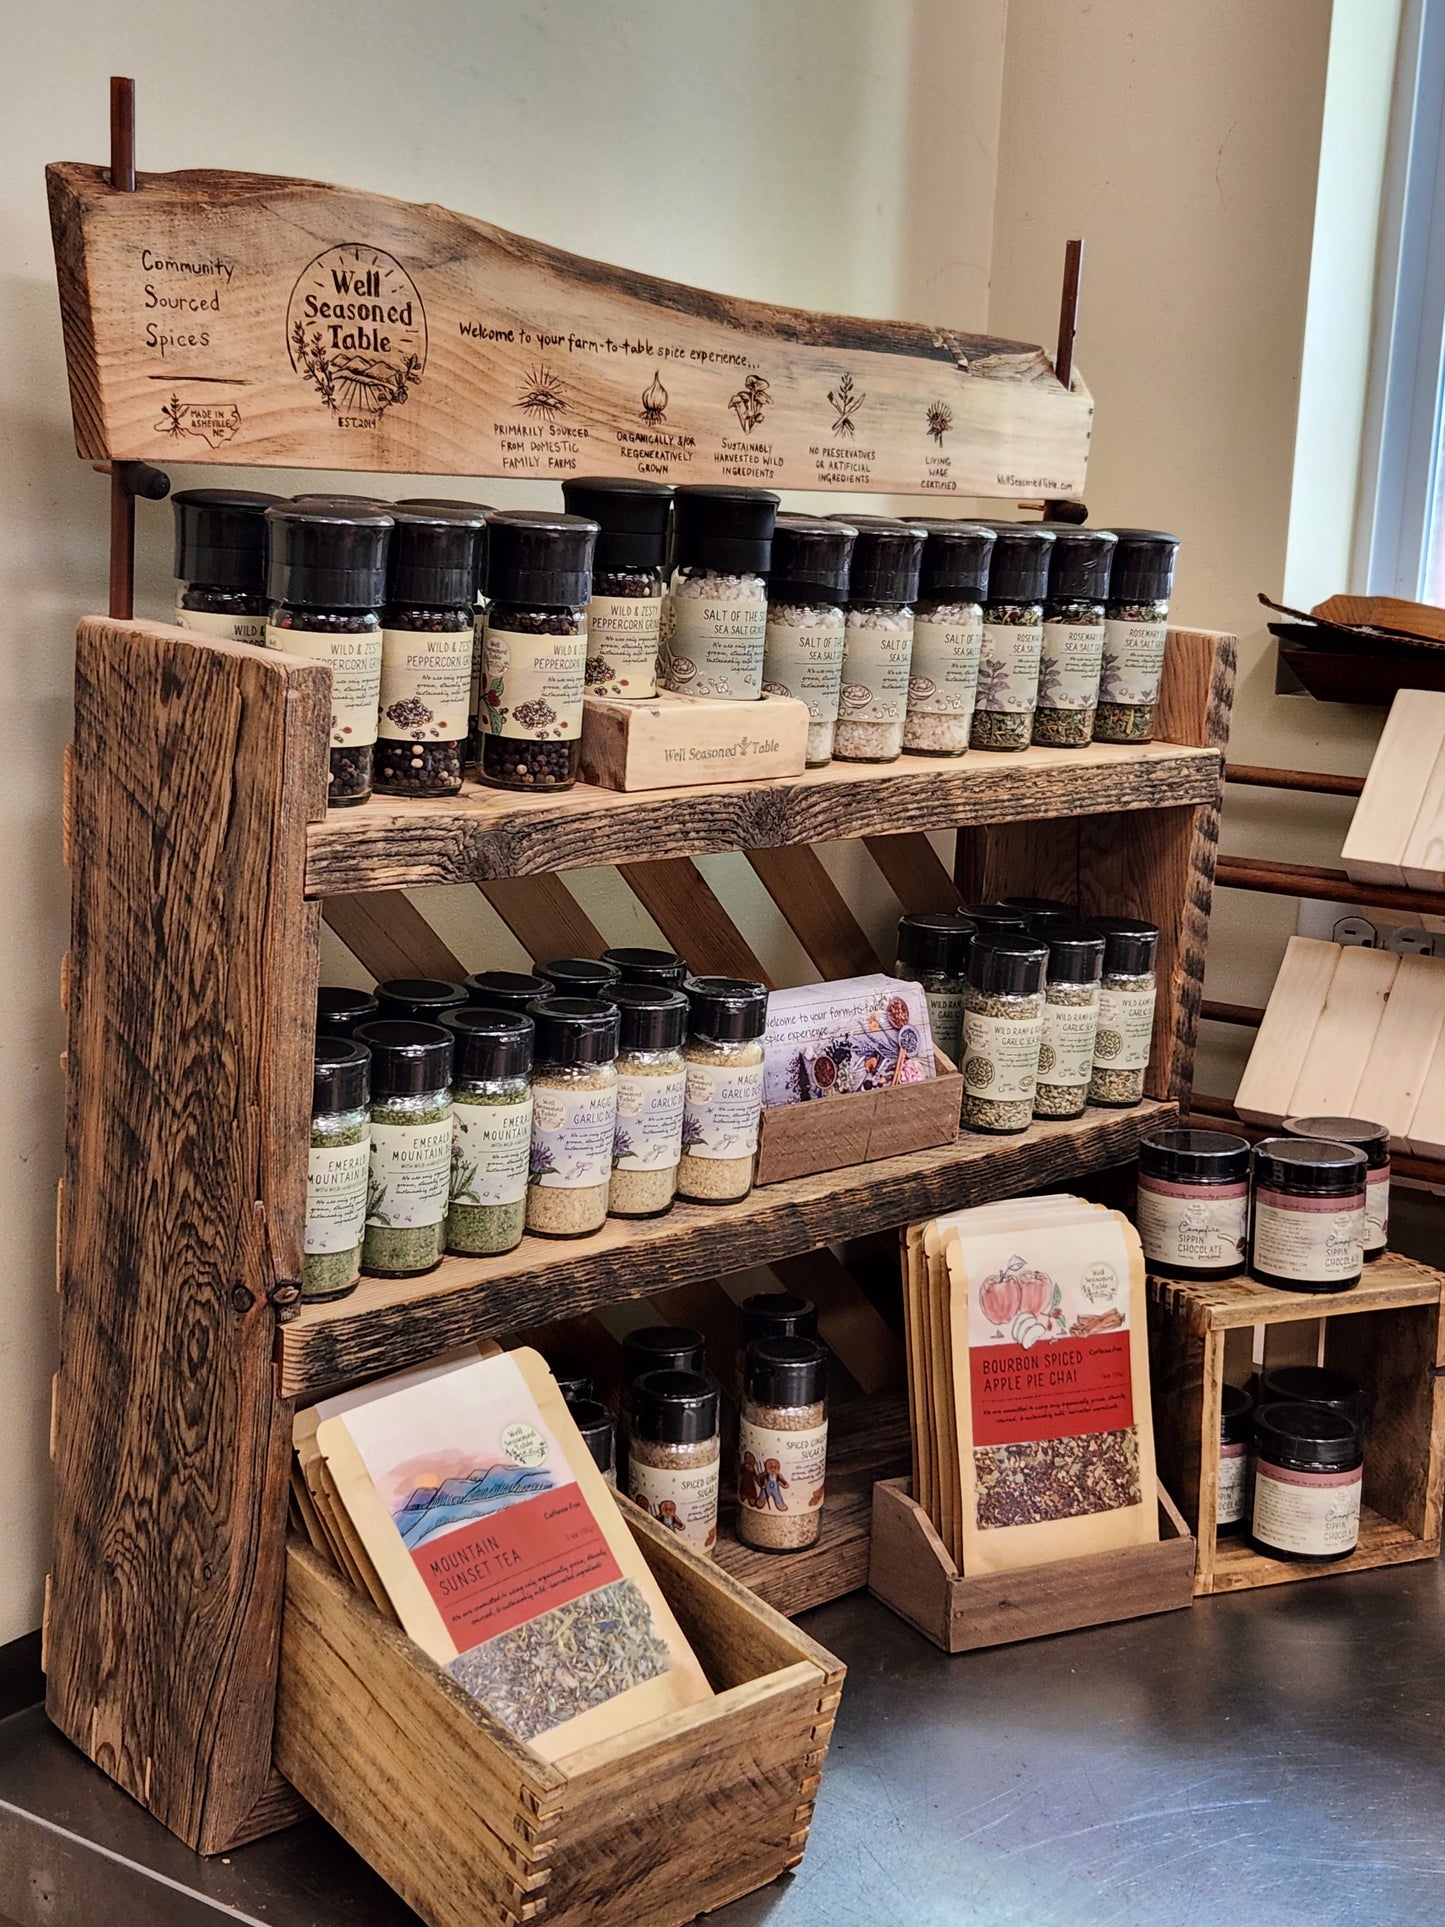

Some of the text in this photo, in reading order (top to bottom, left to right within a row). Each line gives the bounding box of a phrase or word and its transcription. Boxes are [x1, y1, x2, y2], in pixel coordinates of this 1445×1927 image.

[142, 250, 234, 284] Community
[331, 269, 380, 297] Well
[145, 284, 220, 312] Sourced
[304, 294, 412, 326] Seasoned
[146, 323, 210, 357] Spices
[327, 324, 391, 352] Table
[459, 322, 514, 342] Welcome
[519, 329, 532, 343] to
[537, 336, 565, 350] your
[568, 333, 654, 356] farm-to-table
[658, 346, 686, 359] spice
[191, 410, 224, 419] MADE IN
[213, 429, 224, 437] NC
[494, 424, 589, 438] PRIMARILY SOURCED
[617, 431, 674, 447] ORGANICALLY
[501, 440, 579, 453] FROM DOMESTIC
[721, 438, 773, 455] SUSTAINABLY
[621, 447, 693, 461] REGENERATIVELY
[714, 453, 784, 466] HARVESTED WILD
[809, 446, 876, 461] NO PRESERVATIVES
[503, 457, 576, 470] FAMILY FARMS
[816, 460, 871, 472] OR ARTIFICIAL
[925, 457, 951, 466] LIVING
[638, 463, 668, 474] GROWN
[722, 466, 774, 478] INGREDIENTS
[929, 468, 948, 477] WAGE
[818, 473, 869, 484] INGREDIENTS
[921, 480, 957, 490] CERTIFIED
[610, 605, 631, 617] WILD
[633, 606, 639, 617] &
[703, 609, 728, 621] SALT
[730, 611, 742, 622] OF
[592, 617, 643, 630] PEPPERCORN
[714, 624, 748, 635] SEA SALT
[234, 624, 257, 637] WILD
[799, 637, 832, 648] SALT OF
[944, 633, 965, 644] SALT
[1125, 639, 1138, 647] SEA
[331, 643, 362, 655] WILD &
[427, 641, 457, 653] WILD &
[553, 644, 571, 656] WILD
[881, 640, 900, 650] SALT
[1012, 645, 1024, 653] SEA
[1064, 643, 1077, 651] SEA
[809, 652, 821, 660] SEA
[889, 653, 900, 662] SEA
[953, 647, 964, 656] SEA
[407, 655, 461, 667] PEPPERCORN
[664, 739, 780, 762] Well Seasoned Table
[931, 1000, 961, 1009] WILD RAM
[1122, 999, 1137, 1007] WILD
[799, 1012, 809, 1022] to
[810, 1011, 826, 1023] your
[1056, 1013, 1072, 1021] WILD
[994, 1026, 1011, 1035] WILD
[764, 1033, 785, 1046] spice
[1001, 1037, 1024, 1046] GARLIC
[721, 1089, 750, 1099] GARLIC
[651, 1097, 678, 1109] GARLIC
[573, 1112, 603, 1125] GARLIC
[483, 1126, 528, 1140] MOUNTAIN
[392, 1146, 443, 1161] MOUNTAIN
[307, 1169, 359, 1185] MOUNTAIN
[1178, 1220, 1219, 1236] Campfire
[1177, 1244, 1222, 1254] CHOCOLATE
[983, 1350, 1083, 1375] BOURBON SPICED
[984, 1368, 1077, 1392] APPLE PIE CHAI
[786, 1440, 809, 1450] SPICED
[801, 1447, 820, 1459] SUGAR
[682, 1478, 705, 1490] SPICED
[430, 1536, 499, 1577] MOUNTAIN
[439, 1549, 522, 1596] SUNSET TEA
